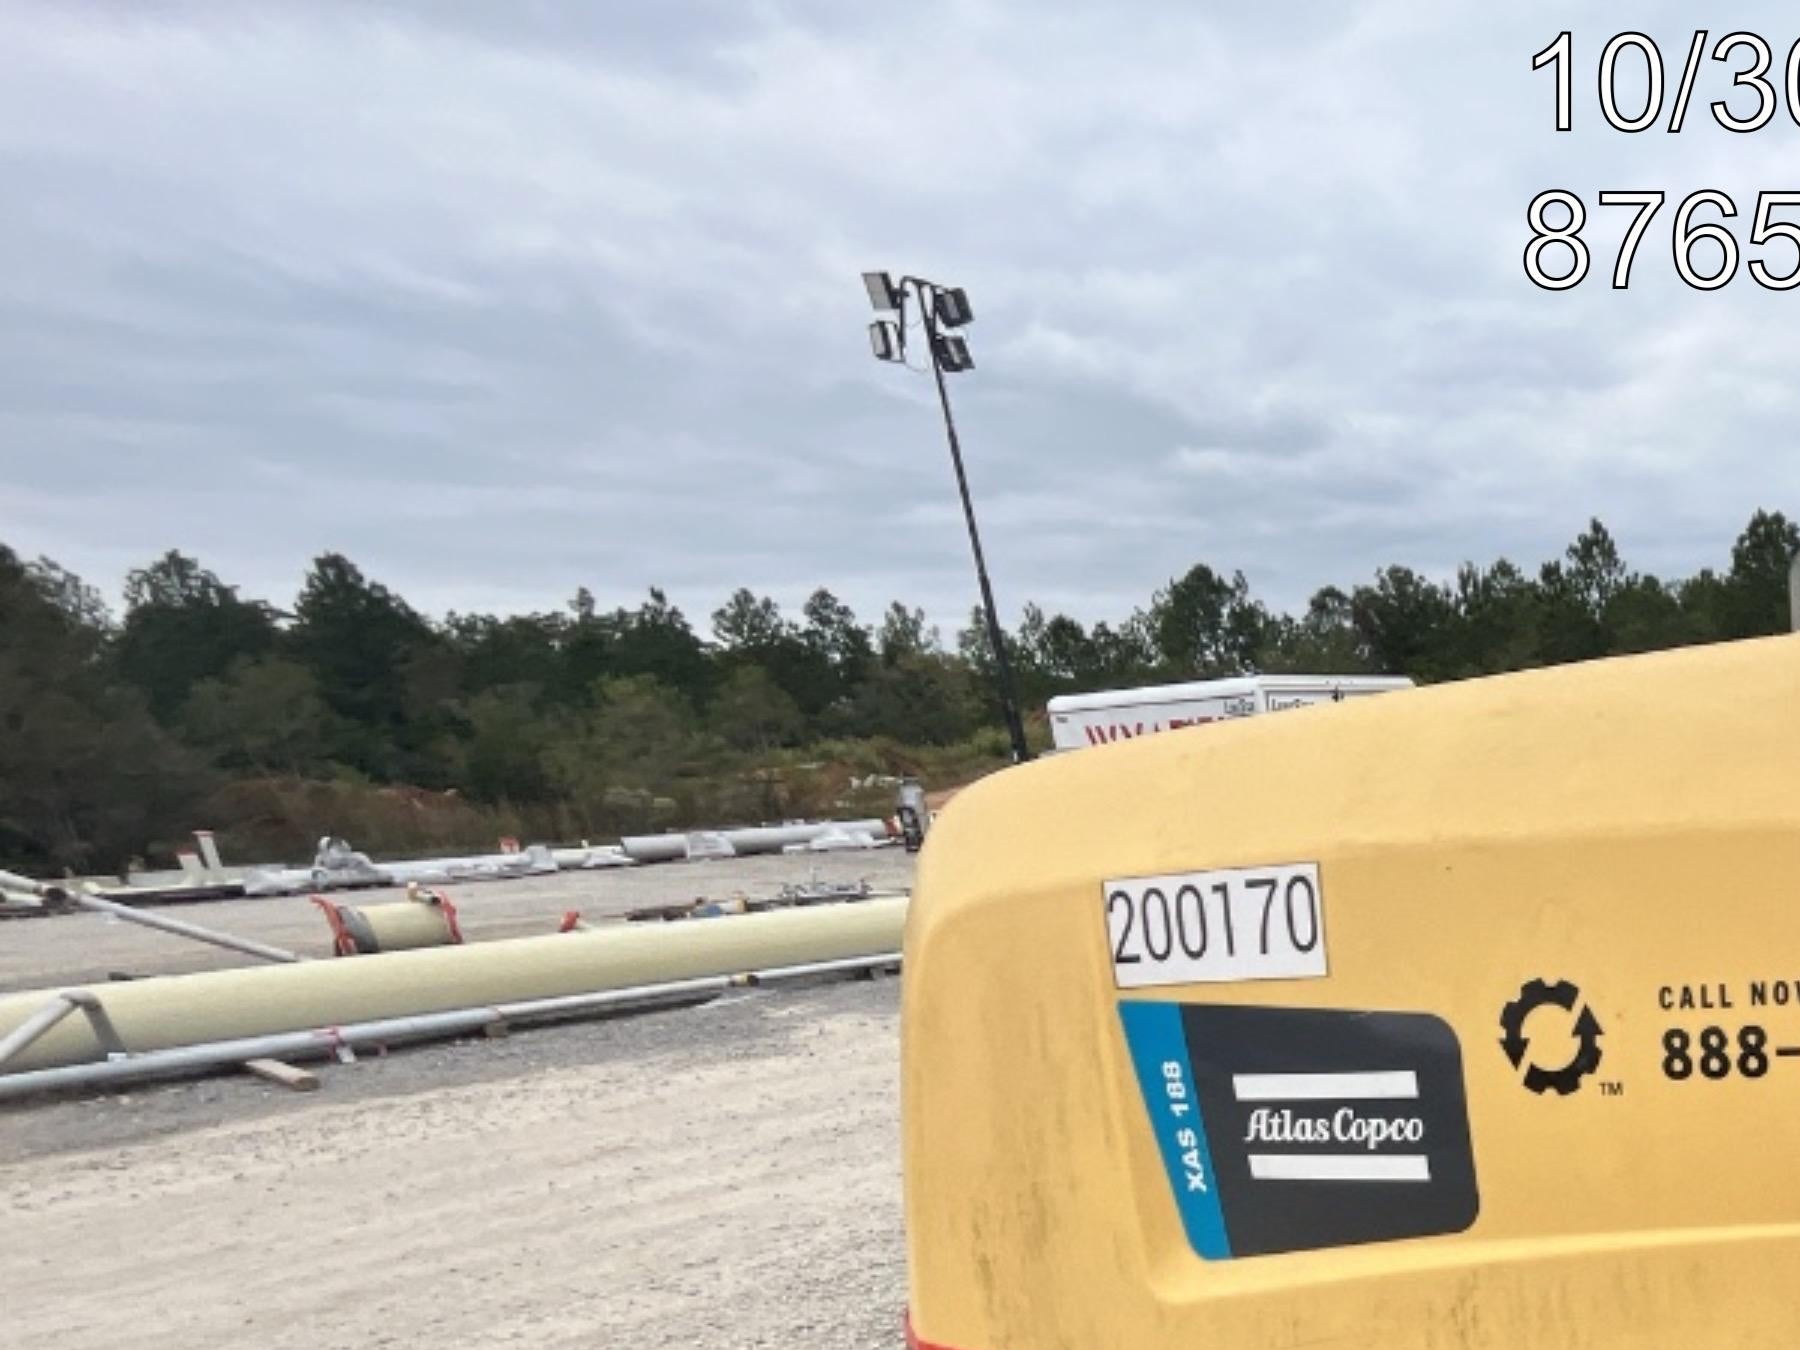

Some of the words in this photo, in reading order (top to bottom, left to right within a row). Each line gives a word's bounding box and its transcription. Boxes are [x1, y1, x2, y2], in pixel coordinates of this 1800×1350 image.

[1106, 874, 1319, 964] 200170
[1658, 983, 1733, 1011] CALL
[1161, 1060, 1190, 1118] 188
[1243, 1108, 1331, 1143] Atlas
[1332, 1106, 1424, 1150] Copco
[1176, 1127, 1208, 1193] XAS
